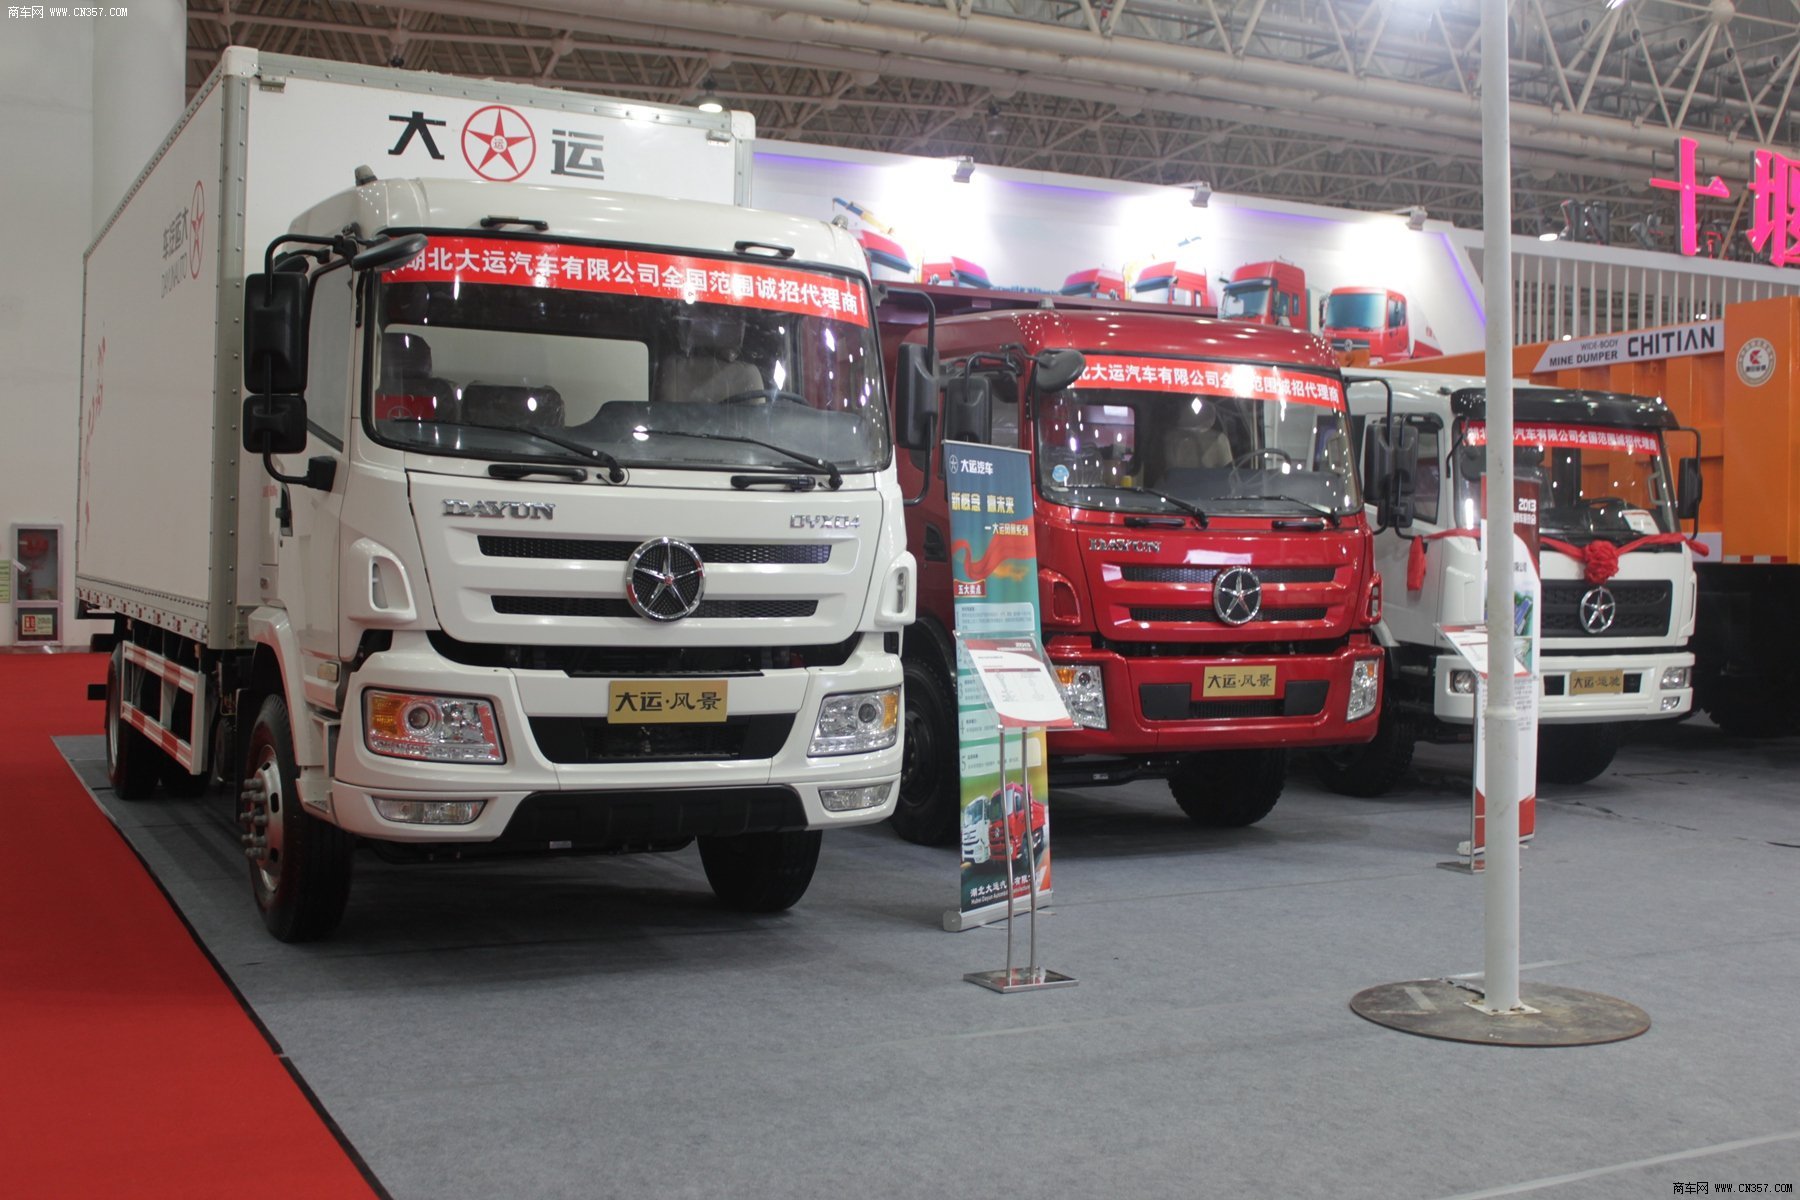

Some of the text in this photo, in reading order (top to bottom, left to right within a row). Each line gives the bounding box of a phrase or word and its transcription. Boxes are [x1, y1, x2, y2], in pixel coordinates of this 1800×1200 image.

[388, 111, 605, 180] 大 运
[1580, 338, 1619, 351] WIDE-BODY
[1627, 326, 1715, 358] CHITIAN
[1549, 350, 1618, 367] MINE DUMPER
[960, 459, 994, 475] 大运汽车
[442, 499, 556, 520] DAYUN
[951, 491, 981, 512] 新概念
[1518, 498, 1537, 513] 2013
[1088, 537, 1162, 553] DAYUN
[1207, 673, 1273, 689] 大运·风景
[615, 691, 722, 712] 大运·风景
